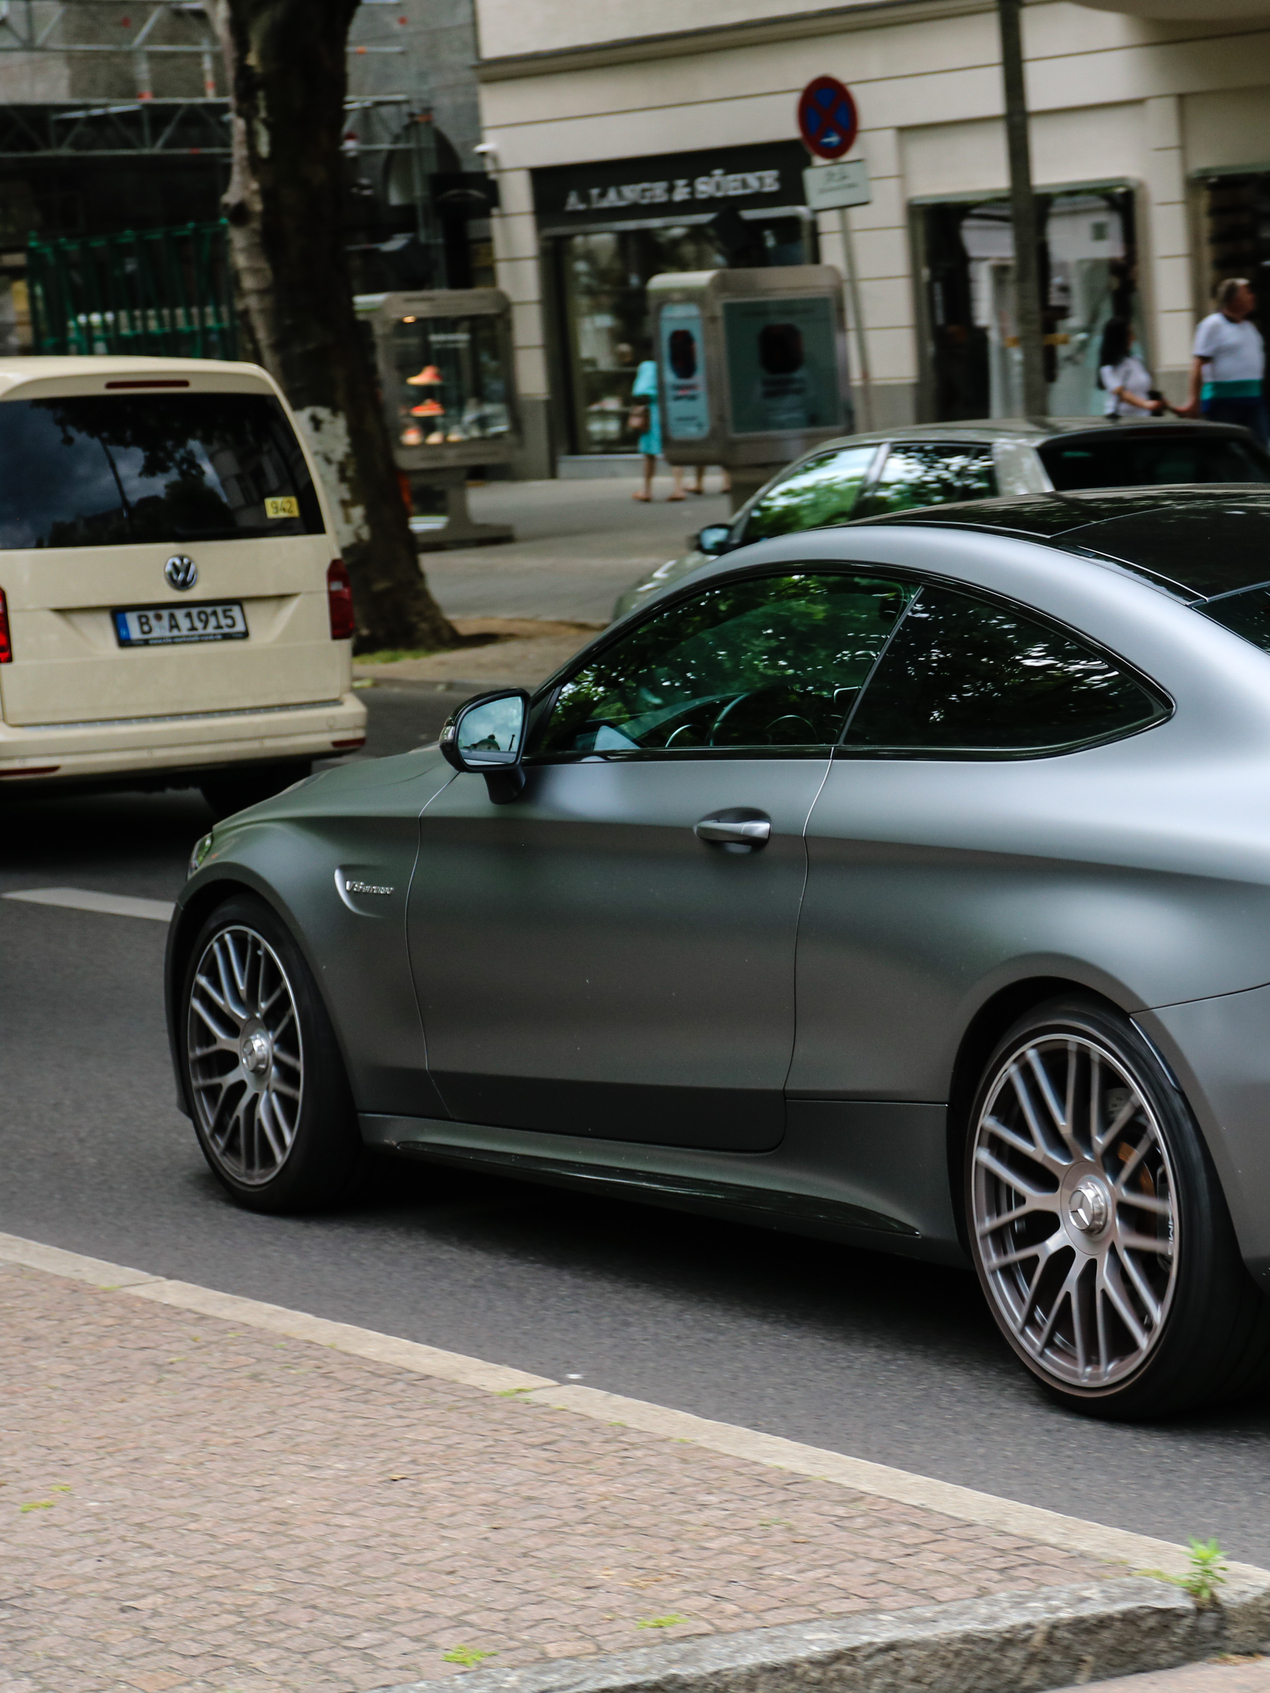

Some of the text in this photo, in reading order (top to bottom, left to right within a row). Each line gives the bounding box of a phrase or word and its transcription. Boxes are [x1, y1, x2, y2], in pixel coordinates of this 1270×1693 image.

[587, 181, 669, 208] LANGE
[672, 179, 691, 202] &
[694, 168, 780, 199] SÖHNE
[137, 613, 152, 635] B
